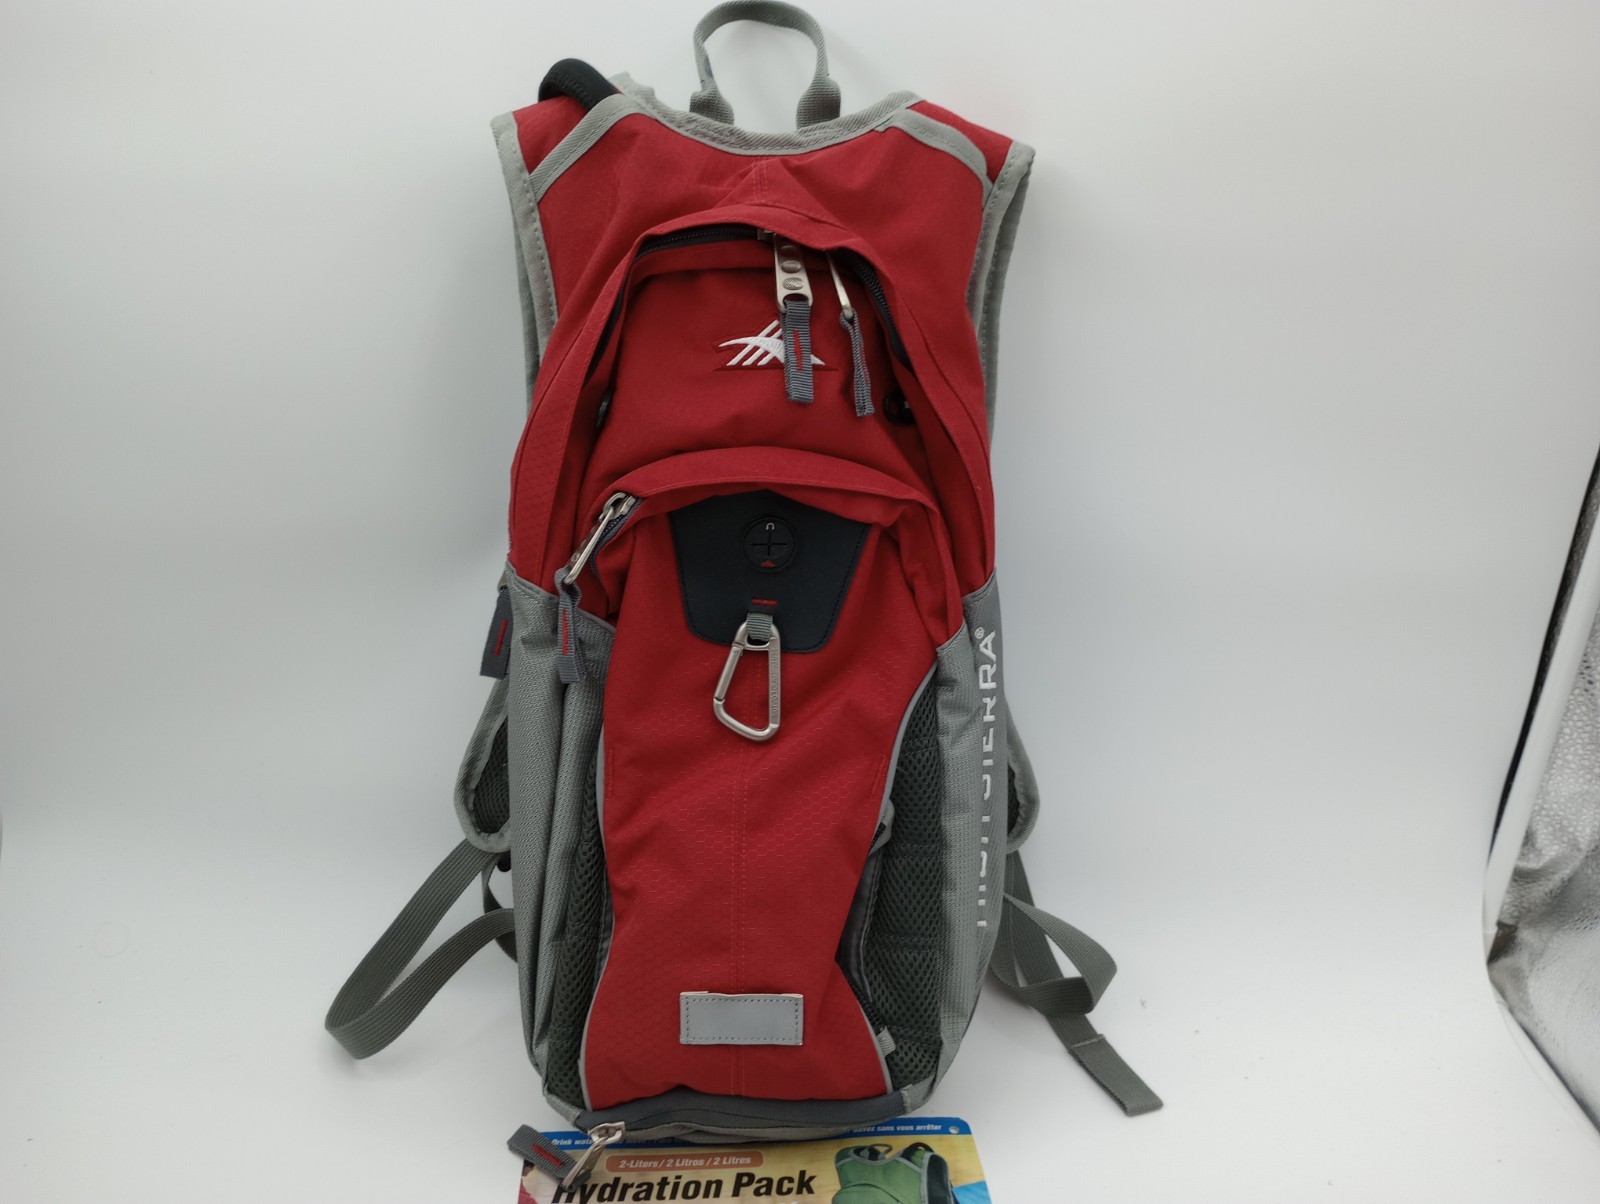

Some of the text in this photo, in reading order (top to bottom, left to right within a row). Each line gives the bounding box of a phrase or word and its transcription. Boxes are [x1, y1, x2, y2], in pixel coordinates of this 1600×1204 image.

[618, 1158, 658, 1169] 2-Liters
[666, 1158, 673, 1168] 2
[675, 1157, 705, 1168] Litros
[713, 1156, 720, 1166] 2
[722, 1155, 751, 1166] Litres
[732, 1169, 817, 1198] Pack
